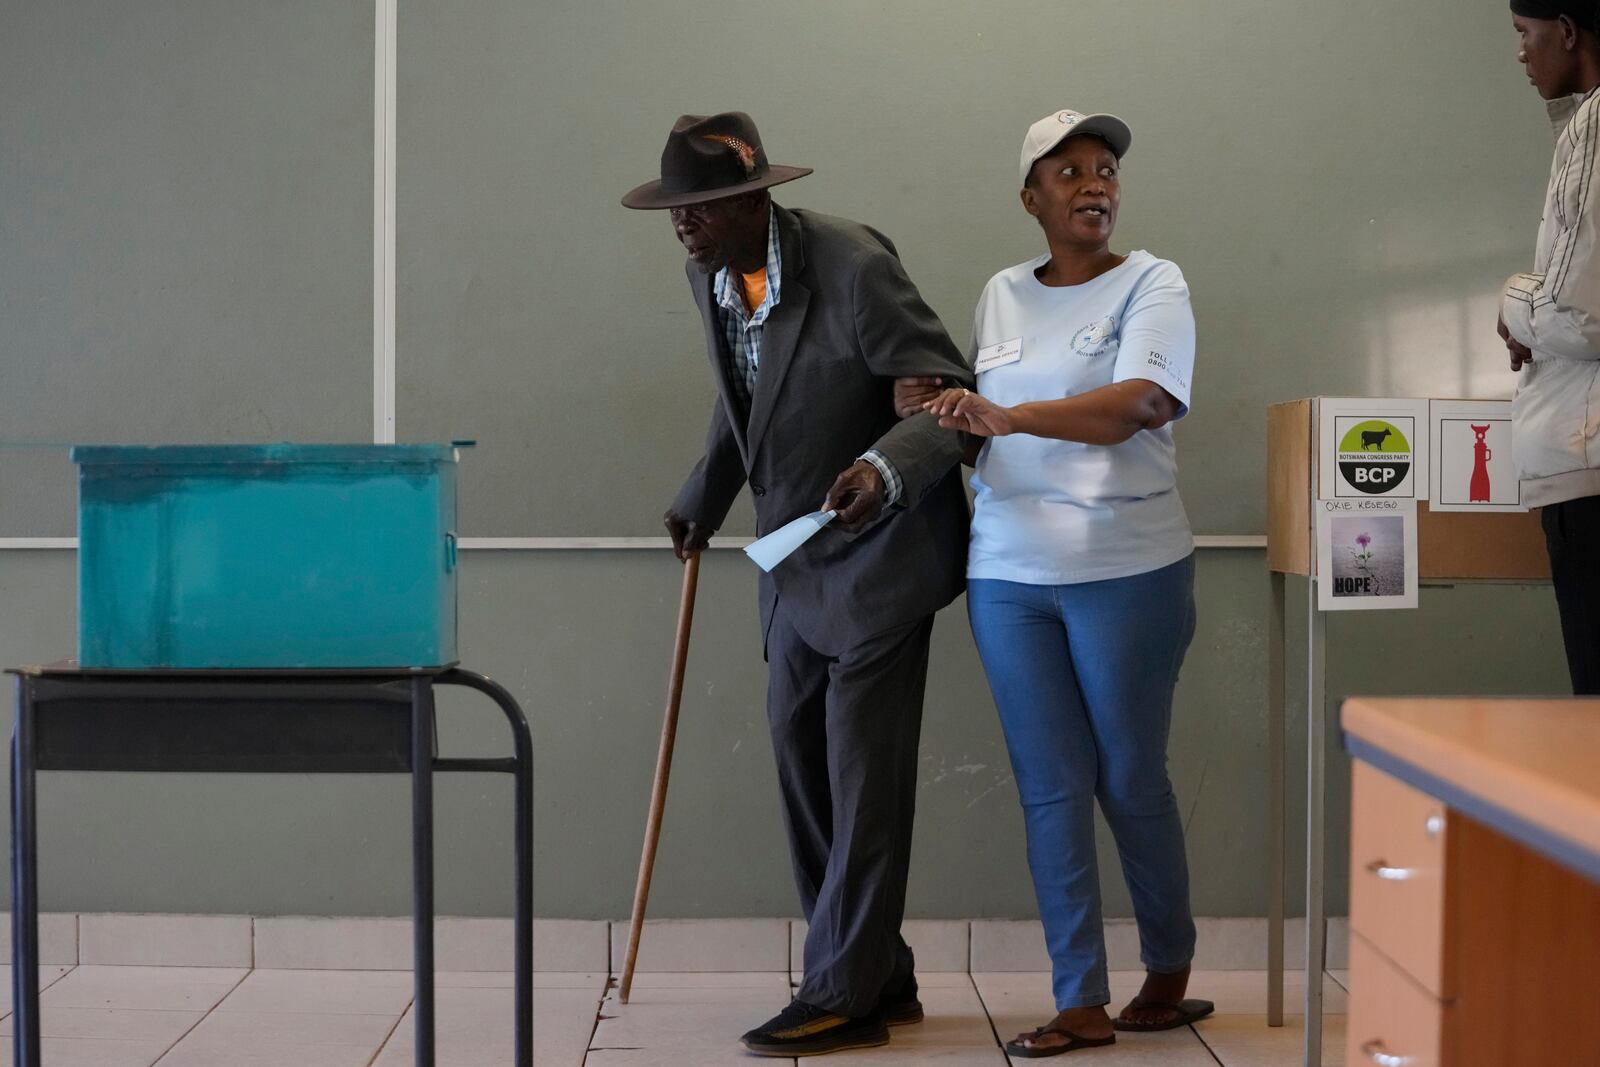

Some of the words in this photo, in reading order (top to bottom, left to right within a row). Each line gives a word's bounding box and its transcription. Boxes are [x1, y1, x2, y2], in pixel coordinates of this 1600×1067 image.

[1150, 351, 1168, 363] TOLL
[1147, 358, 1166, 369] 0800
[1355, 467, 1395, 483] BCP
[1326, 501, 1352, 511] OKIE
[1358, 500, 1398, 509] KESEGO
[1334, 577, 1371, 593] HOPE
